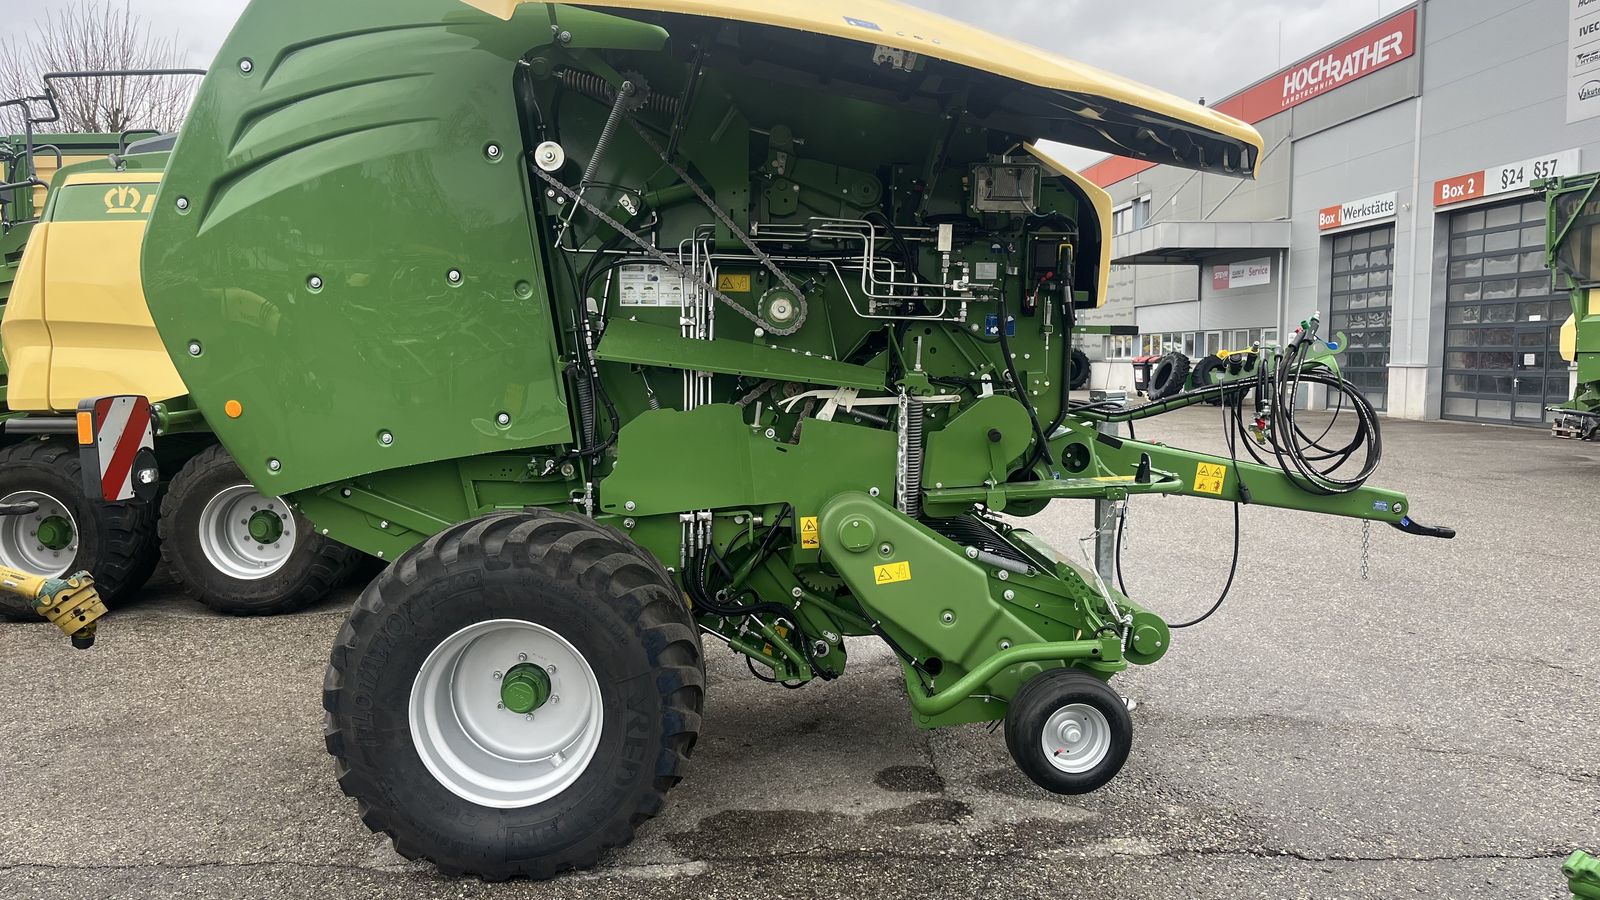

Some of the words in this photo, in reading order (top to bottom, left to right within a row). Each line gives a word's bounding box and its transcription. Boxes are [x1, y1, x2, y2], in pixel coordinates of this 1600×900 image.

[1282, 31, 1403, 98] HOCHRATHER
[1281, 79, 1333, 107] LANDTECHNIK
[1501, 168, 1524, 190] §24
[1533, 159, 1558, 179] §57
[1442, 183, 1464, 200] Box
[1467, 178, 1475, 194] 2
[1319, 213, 1335, 226] Box
[1343, 200, 1394, 220] Werkstätte
[1248, 265, 1268, 277] Service
